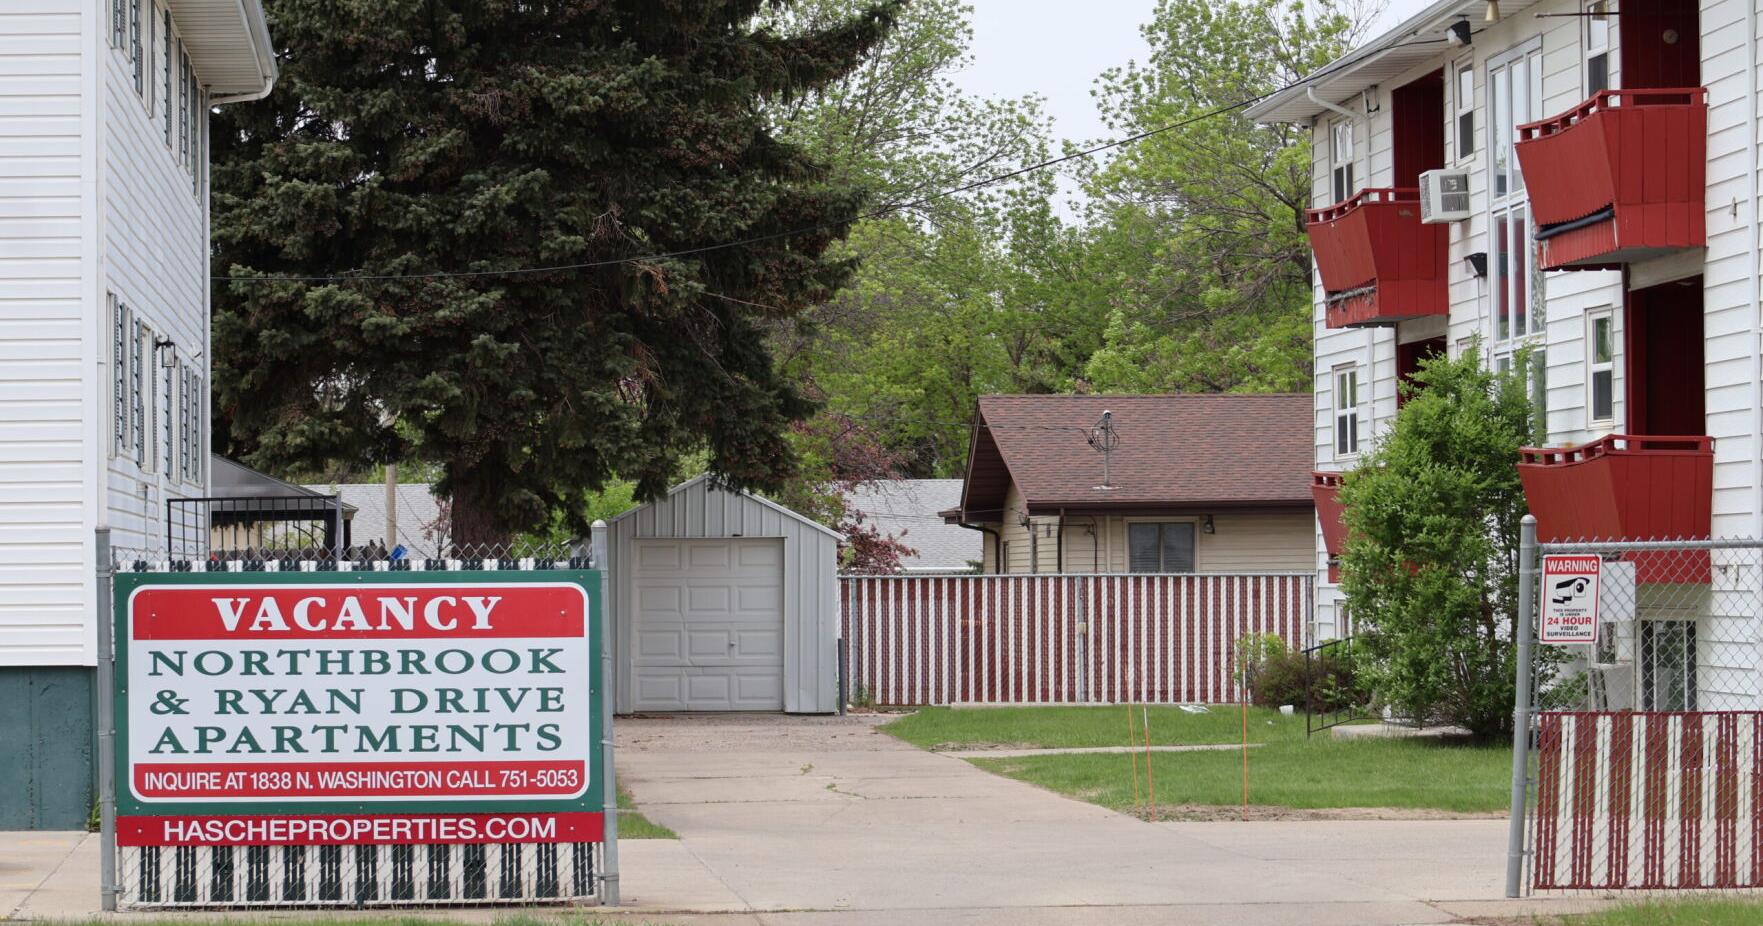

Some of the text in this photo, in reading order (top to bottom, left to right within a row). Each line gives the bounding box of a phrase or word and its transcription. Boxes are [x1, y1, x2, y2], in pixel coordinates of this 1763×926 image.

[1547, 560, 1597, 572] WARNING
[212, 596, 502, 632] VACANCY
[1562, 616, 1591, 624] HOUR
[148, 648, 566, 676] NORTHBROOK
[149, 686, 566, 715] & RYAN DRIVE
[147, 723, 563, 754] APARTMENTS
[144, 769, 578, 791] INQUIRE AT 1838 N. WASHINGTON CALL 751-5053
[163, 817, 556, 842] HASCHEPROPERTIES.COM
